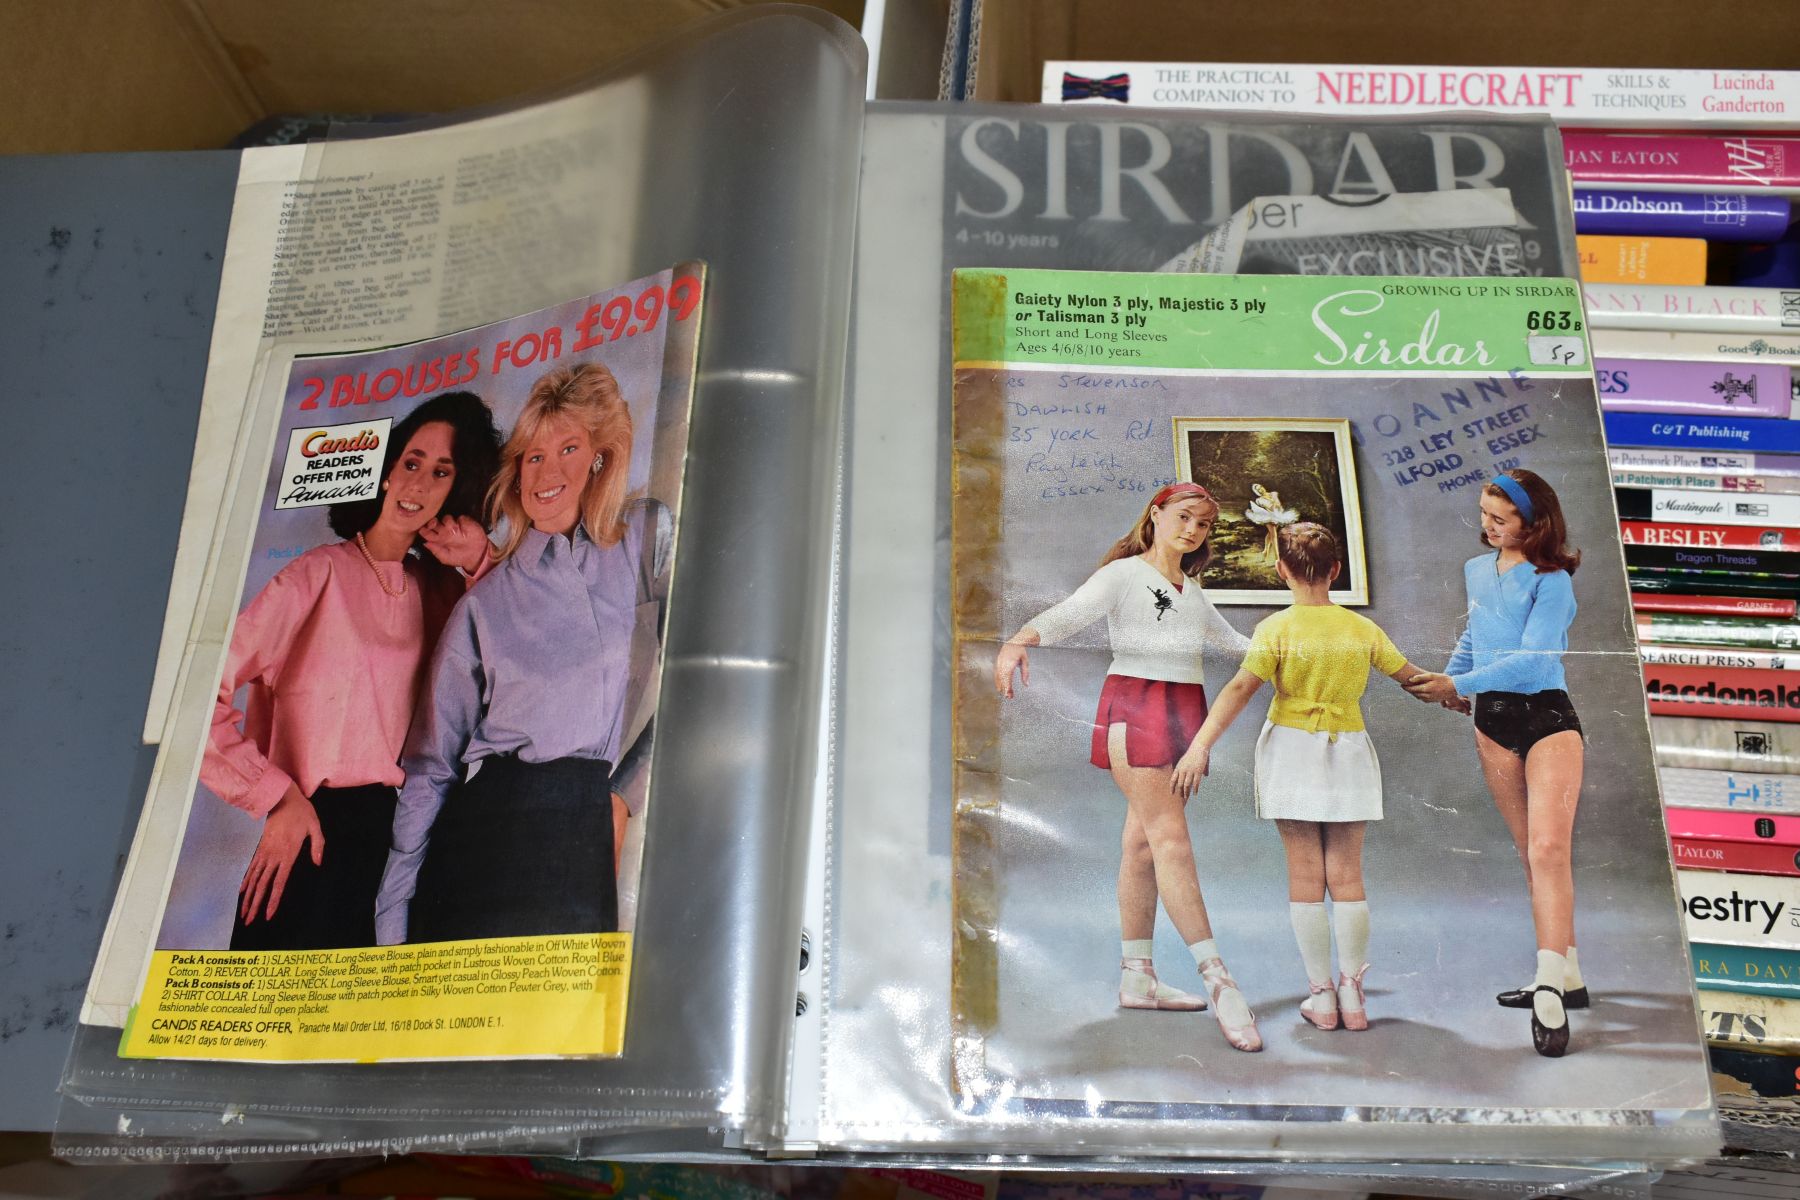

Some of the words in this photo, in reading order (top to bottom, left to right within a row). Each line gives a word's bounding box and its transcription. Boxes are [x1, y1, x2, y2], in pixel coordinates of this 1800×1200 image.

[1156, 69, 1191, 84] THE
[1196, 70, 1295, 85] PRACTICAL
[1607, 75, 1654, 89] SKILLS
[1658, 75, 1670, 89] &
[1712, 73, 1775, 91] Lucinda
[1153, 88, 1268, 103] COMPANION
[1273, 89, 1296, 103] TO
[1315, 72, 1582, 107] NEEDLECRAFT
[1592, 94, 1687, 111] TECHNIQUES
[1702, 95, 1785, 113] Ganderton
[1565, 150, 1603, 166] JAN
[1611, 150, 1680, 165] EATON
[955, 117, 1539, 229] SIRDAR
[1600, 196, 1683, 213] Dobson
[1008, 231, 1060, 249] years
[1299, 243, 1522, 277] EXCLUSIVE
[1382, 284, 1462, 297] GROWING
[1467, 286, 1489, 297] UP
[1493, 286, 1511, 297] IN
[1515, 286, 1577, 298] SIRDAR
[1015, 292, 1061, 308] Gaiety
[1068, 294, 1107, 309] Nylon
[1113, 296, 1122, 307] 3
[1127, 297, 1153, 311] ply,
[1159, 297, 1225, 312] Majestic
[1230, 299, 1239, 310] 3
[1244, 299, 1266, 313] ply
[1663, 294, 1768, 315] BLACK
[1015, 312, 1032, 321] or
[1037, 310, 1105, 324] Talisman
[1111, 312, 1119, 324] 3
[1125, 313, 1147, 327] ply
[1015, 327, 1050, 338] Short
[1056, 328, 1079, 339] and
[1085, 329, 1118, 343] Long
[1122, 330, 1168, 342] Sleeves
[1311, 289, 1497, 366] Sirdar
[299, 377, 325, 411] 2
[329, 348, 480, 409] BLOUSES
[491, 326, 563, 375] FOR
[573, 275, 701, 353] £9.99
[1016, 342, 1047, 355] Ages
[1051, 343, 1104, 357] 4/6/8/10
[1108, 347, 1141, 359] years
[1718, 344, 1748, 355] Good
[1382, 445, 1415, 467] 328
[1420, 430, 1455, 454] LEY
[1462, 403, 1531, 439] STREET
[1688, 425, 1750, 442] Publishing
[301, 429, 380, 458] Candis
[306, 454, 364, 470] READERS
[1394, 453, 1464, 487] ILFORD
[1486, 424, 1547, 456] ESSEX
[1621, 453, 1670, 467] Patchwork
[1673, 456, 1699, 468] Place
[292, 471, 333, 485] OFFER
[335, 467, 372, 482] FROM
[1627, 474, 1683, 487] Patchwork
[1686, 477, 1717, 488] Place
[281, 481, 375, 504] Panache
[1655, 500, 1723, 515] Martingale
[1643, 528, 1727, 548] BESLEY
[1675, 552, 1713, 565] Dragon
[1716, 554, 1758, 566] Threads
[1641, 653, 1700, 665] SEARCH
[1706, 655, 1756, 668] PRESS
[1674, 844, 1724, 860] TAYLOR
[1682, 890, 1785, 934] estry
[171, 954, 196, 965] Pack
[196, 955, 205, 965] A
[206, 955, 246, 965] consists
[247, 954, 260, 965] of:
[262, 955, 271, 967] 1)
[271, 954, 305, 966] SLASH
[335, 953, 358, 965] Long
[358, 951, 386, 963] Sleeve
[417, 948, 437, 960] plain
[438, 946, 455, 957] and
[455, 944, 483, 957] simply
[483, 941, 535, 955] fashionable
[535, 942, 545, 952] in
[546, 940, 560, 951] Off
[562, 939, 590, 950] White
[590, 938, 626, 949] Woven
[165, 978, 192, 988] Pack
[191, 979, 199, 988] B
[200, 979, 241, 989] consists
[242, 979, 256, 989] of:
[257, 979, 266, 991] 1)
[266, 979, 300, 990] SLASH
[330, 978, 353, 990] Long
[353, 976, 381, 987] Sleeve
[413, 973, 438, 985] Smart
[438, 973, 452, 985] yet
[452, 970, 480, 982] casual
[481, 971, 489, 981] in
[490, 968, 521, 981] Glossy
[522, 967, 550, 979] Peach
[551, 966, 586, 977] Woven
[158, 1003, 209, 1013] fashionable
[211, 1003, 256, 1014] concealed
[257, 1003, 273, 1014] full
[274, 1006, 296, 1016] open
[297, 1004, 330, 1016] placket.
[152, 1019, 197, 1031] CANDIS
[200, 1020, 253, 1032] READERS
[298, 1022, 331, 1034] Panache
[332, 1021, 349, 1032] Mail
[350, 1021, 371, 1032] Order
[373, 1020, 388, 1033] Ltd,
[390, 1019, 412, 1031] 16/18
[413, 1018, 434, 1031] Dock
[449, 1017, 486, 1029] LONDON
[148, 1034, 171, 1045] Allow
[173, 1034, 196, 1045] 14/21
[198, 1035, 218, 1047] days
[220, 1035, 232, 1046] for
[233, 1037, 268, 1048] delivery.
